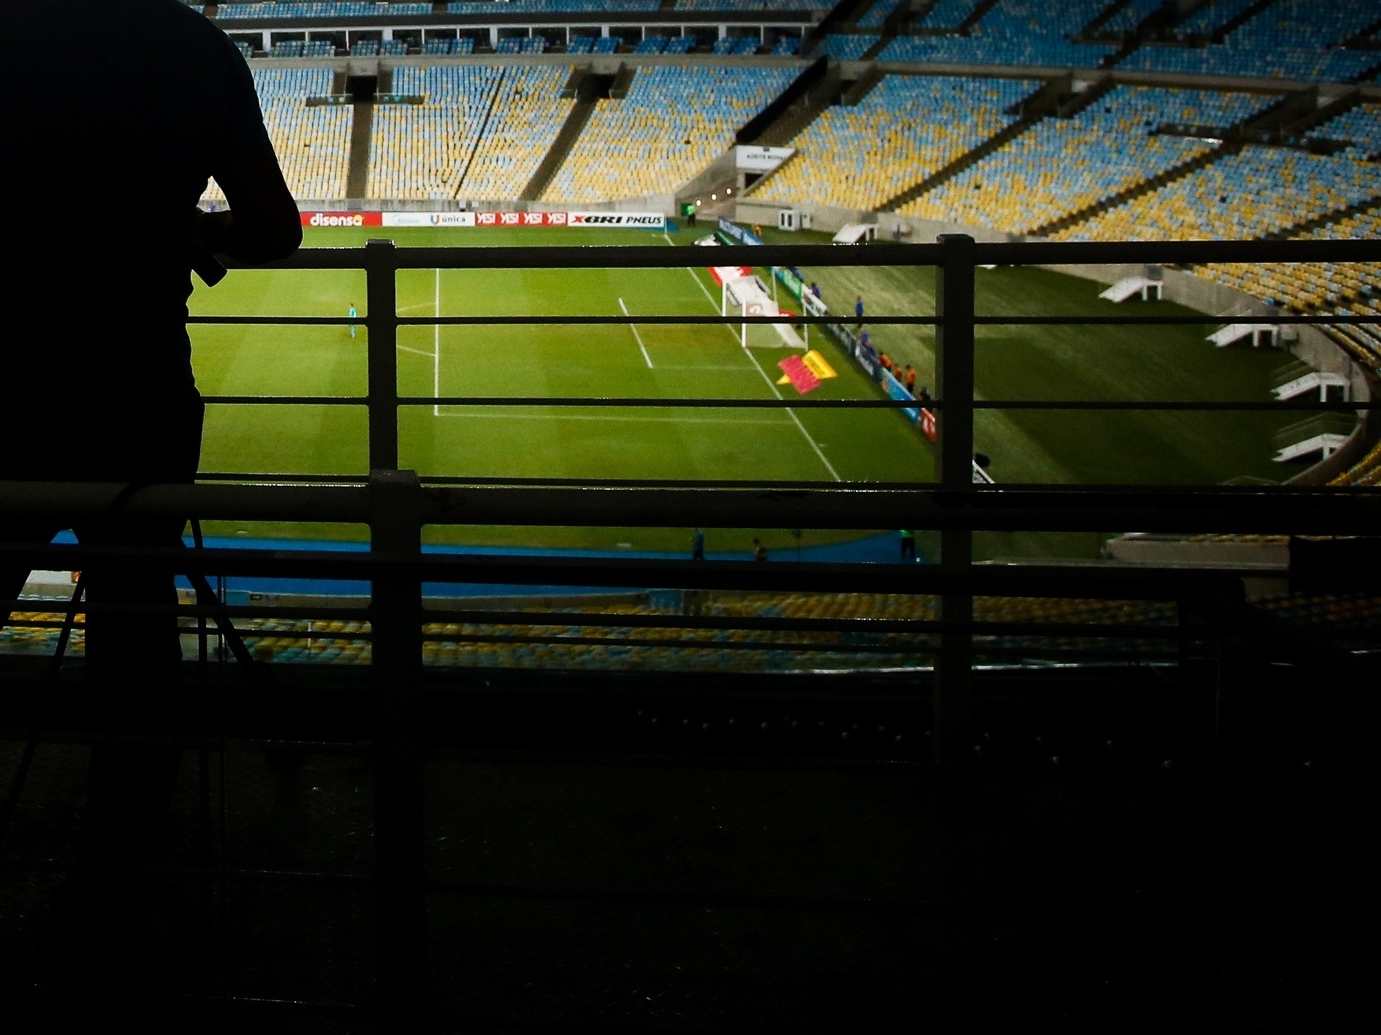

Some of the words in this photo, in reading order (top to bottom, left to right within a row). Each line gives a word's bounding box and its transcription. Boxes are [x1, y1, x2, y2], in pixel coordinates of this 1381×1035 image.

[310, 212, 363, 226] disensa
[477, 213, 495, 224] YES!
[500, 213, 519, 224] YES!
[524, 213, 543, 224] YES!
[547, 213, 567, 224] YES!
[626, 216, 662, 224] PNEUS
